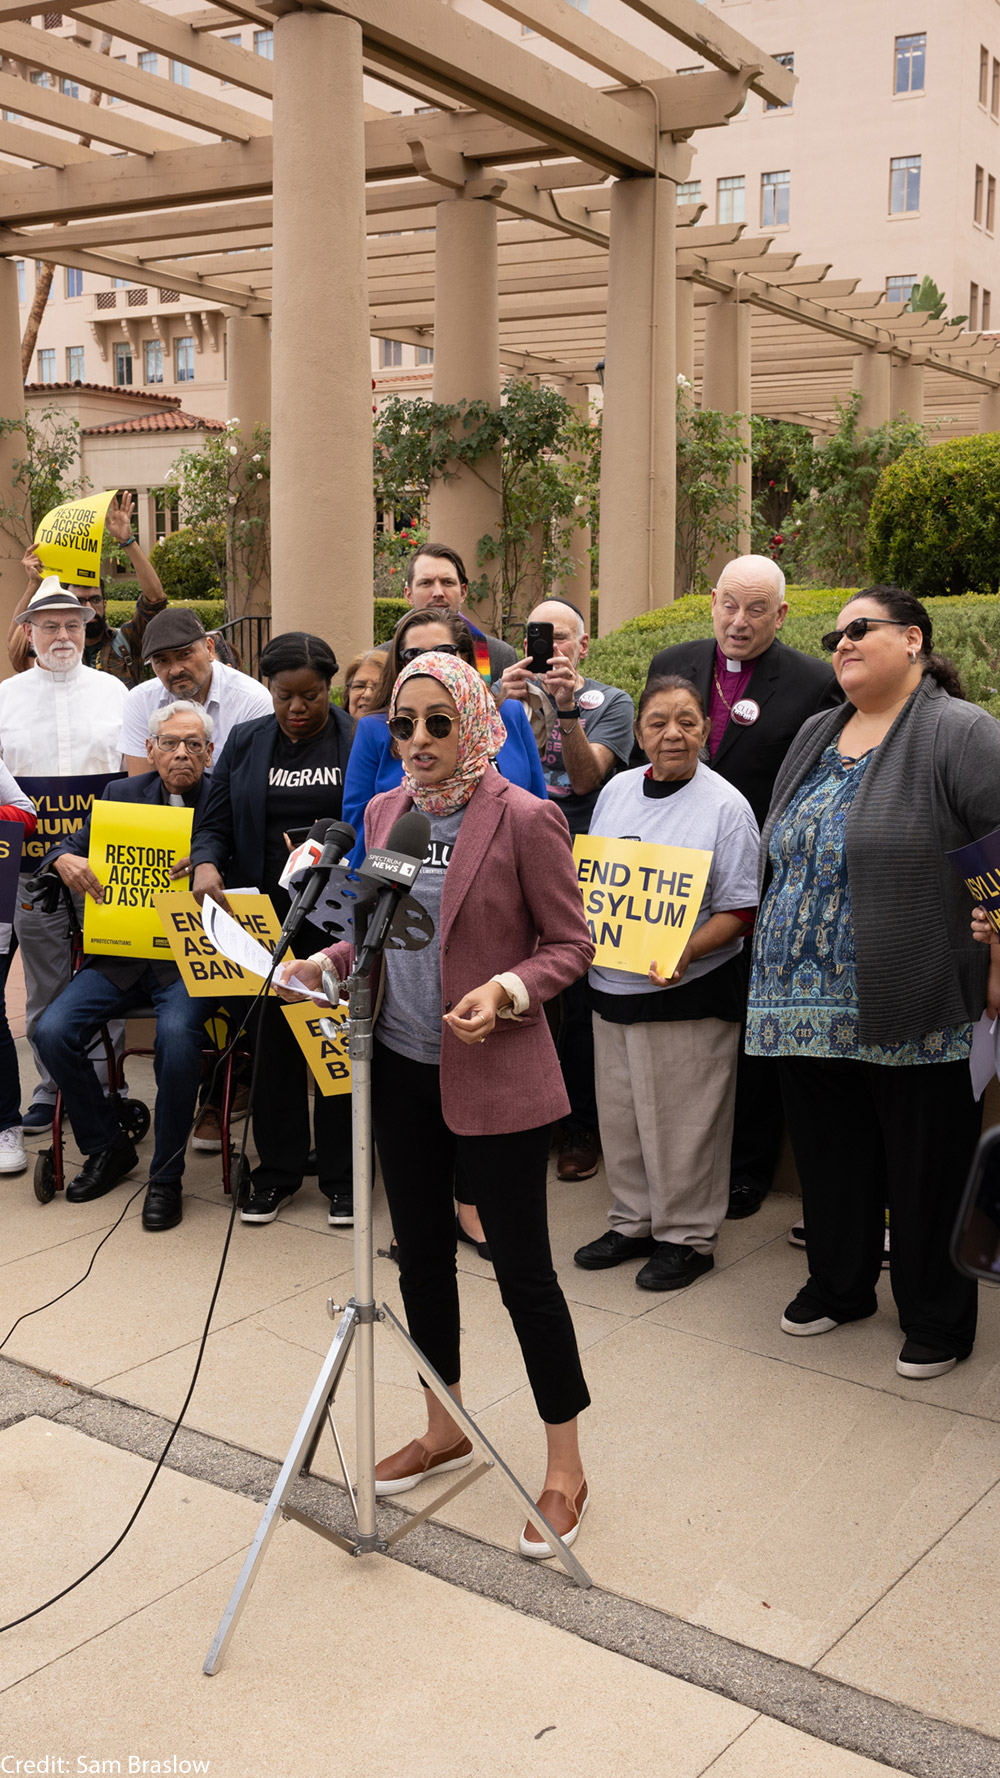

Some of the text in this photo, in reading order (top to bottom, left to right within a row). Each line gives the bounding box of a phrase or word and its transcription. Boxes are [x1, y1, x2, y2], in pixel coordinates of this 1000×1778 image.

[54, 508, 97, 524] RESTORE
[51, 519, 91, 537] ACCESS
[40, 529, 98, 553] TO ASYLUM
[105, 844, 176, 868] RESTORE
[368, 854, 401, 866] SPECTRUM
[108, 865, 171, 888] ACCESS
[371, 860, 400, 873] NEWS
[578, 858, 693, 898] END THE
[580, 888, 687, 928] SYLUM
[233, 914, 271, 934] HE
[91, 938, 132, 947] #PROTECTHAITIANS
[189, 960, 245, 981] BAN
